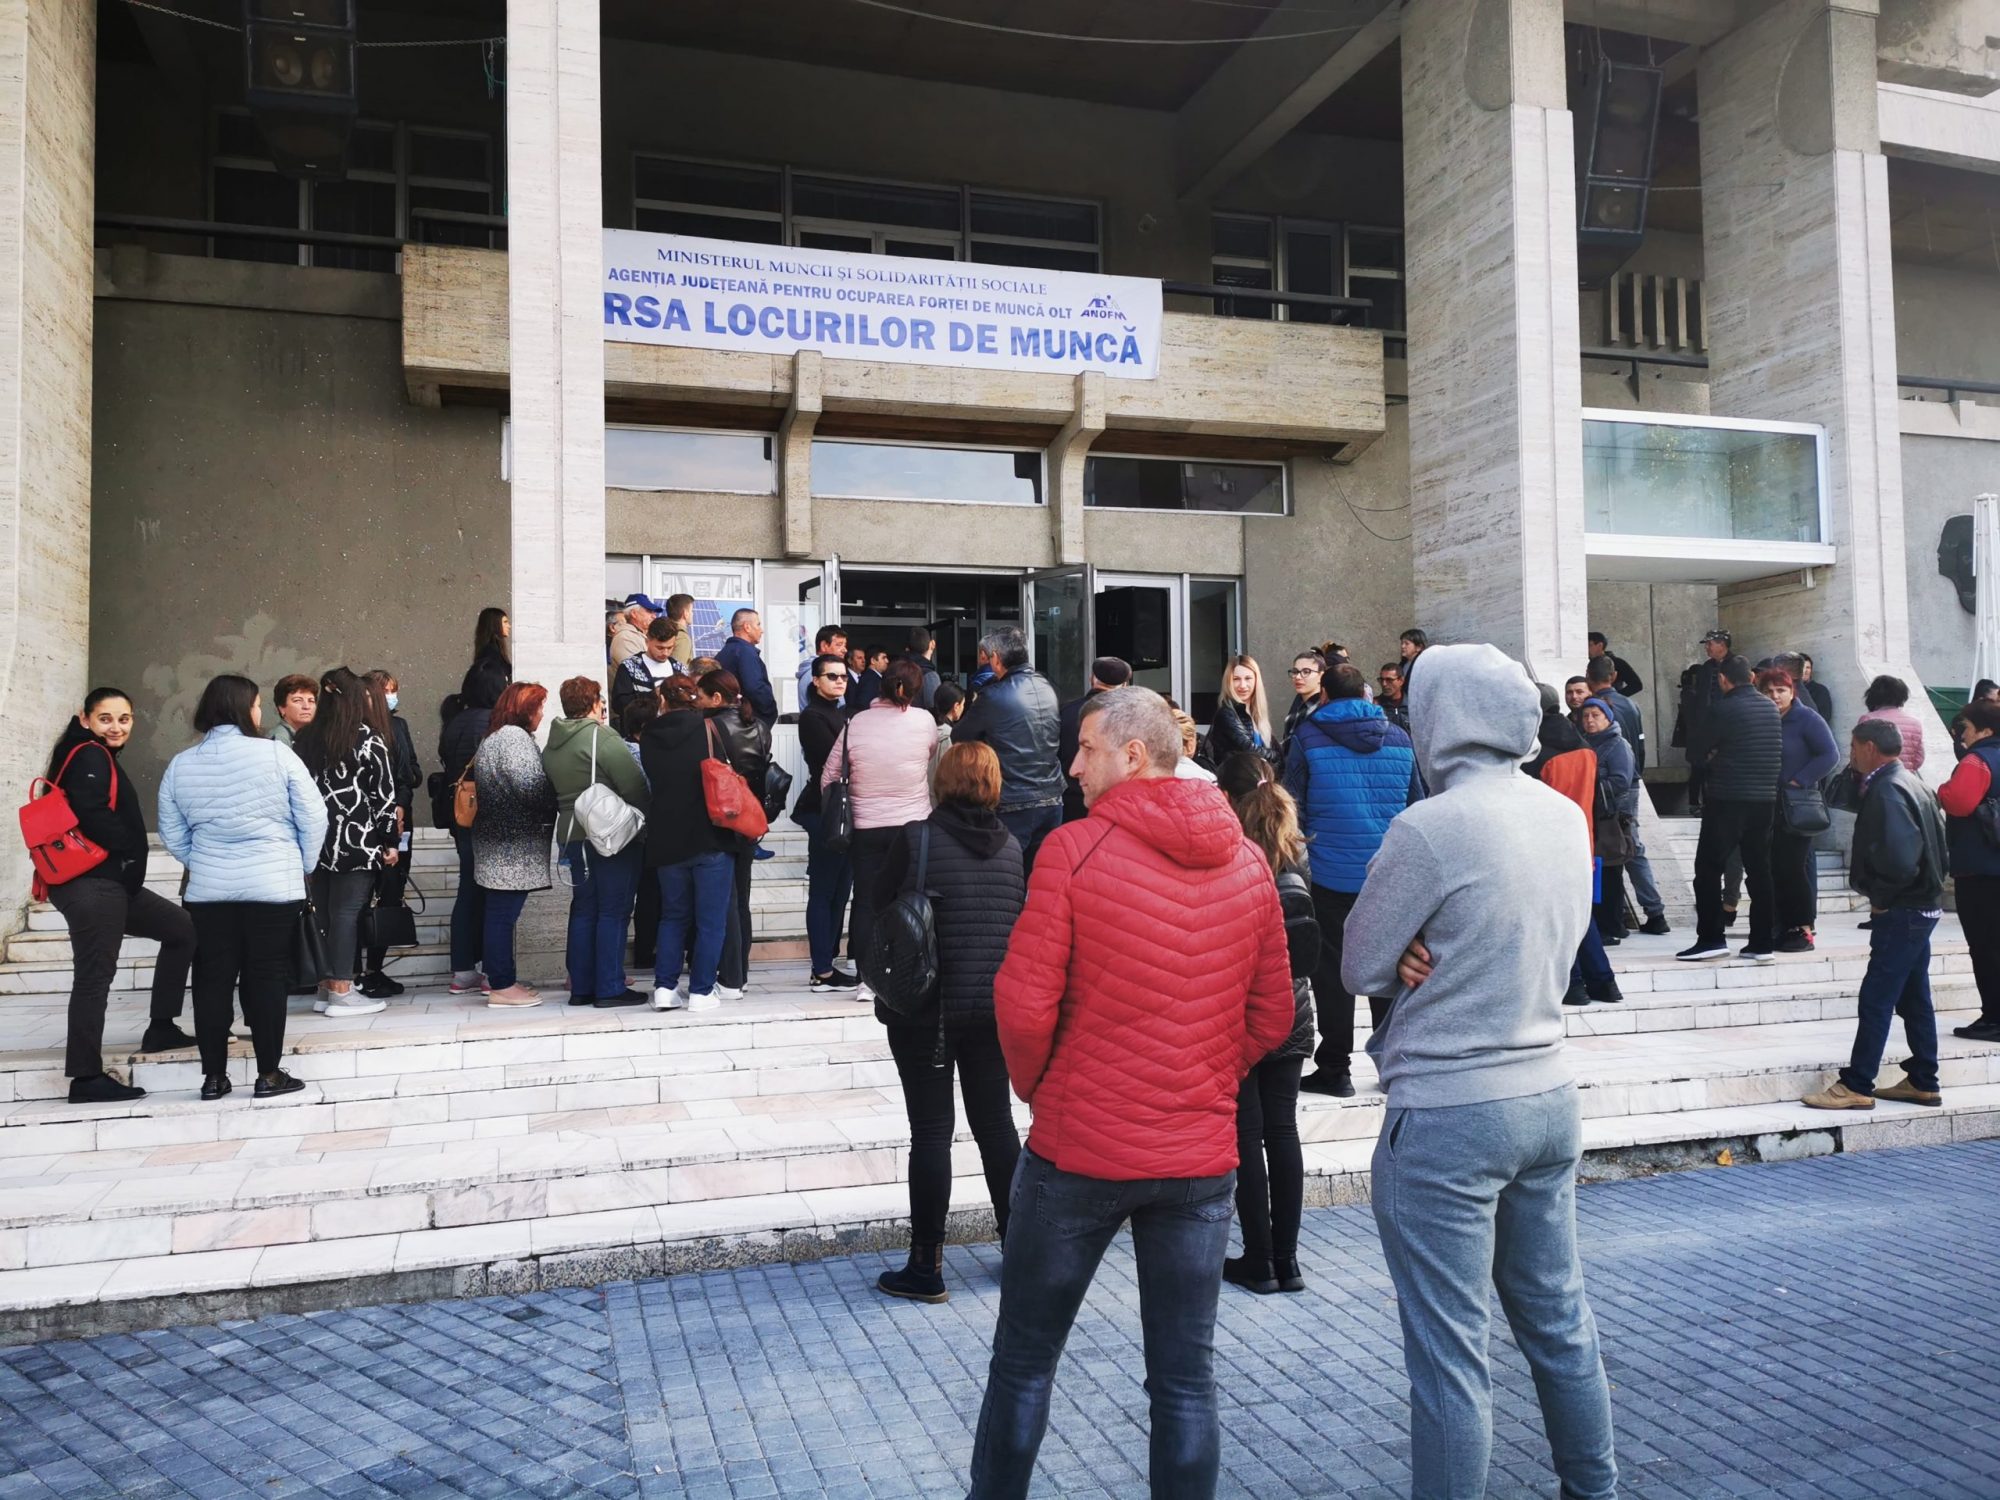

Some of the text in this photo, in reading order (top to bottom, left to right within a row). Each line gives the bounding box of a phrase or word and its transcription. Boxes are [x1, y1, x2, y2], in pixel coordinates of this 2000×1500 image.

[657, 248, 765, 271] MINISTERUL
[769, 260, 832, 278] MUNCII
[981, 278, 1047, 295] SOCIALE
[773, 283, 832, 300] PENTRU
[836, 288, 915, 307] OCUPAREA
[972, 300, 991, 313] DE
[995, 302, 1044, 317] MUNCĂ
[1048, 307, 1072, 319] OLT
[1080, 309, 1127, 320] ANOFM
[704, 301, 935, 350] LOCURILOR
[949, 321, 998, 354] DE
[1010, 325, 1142, 365] MUNCĂ
